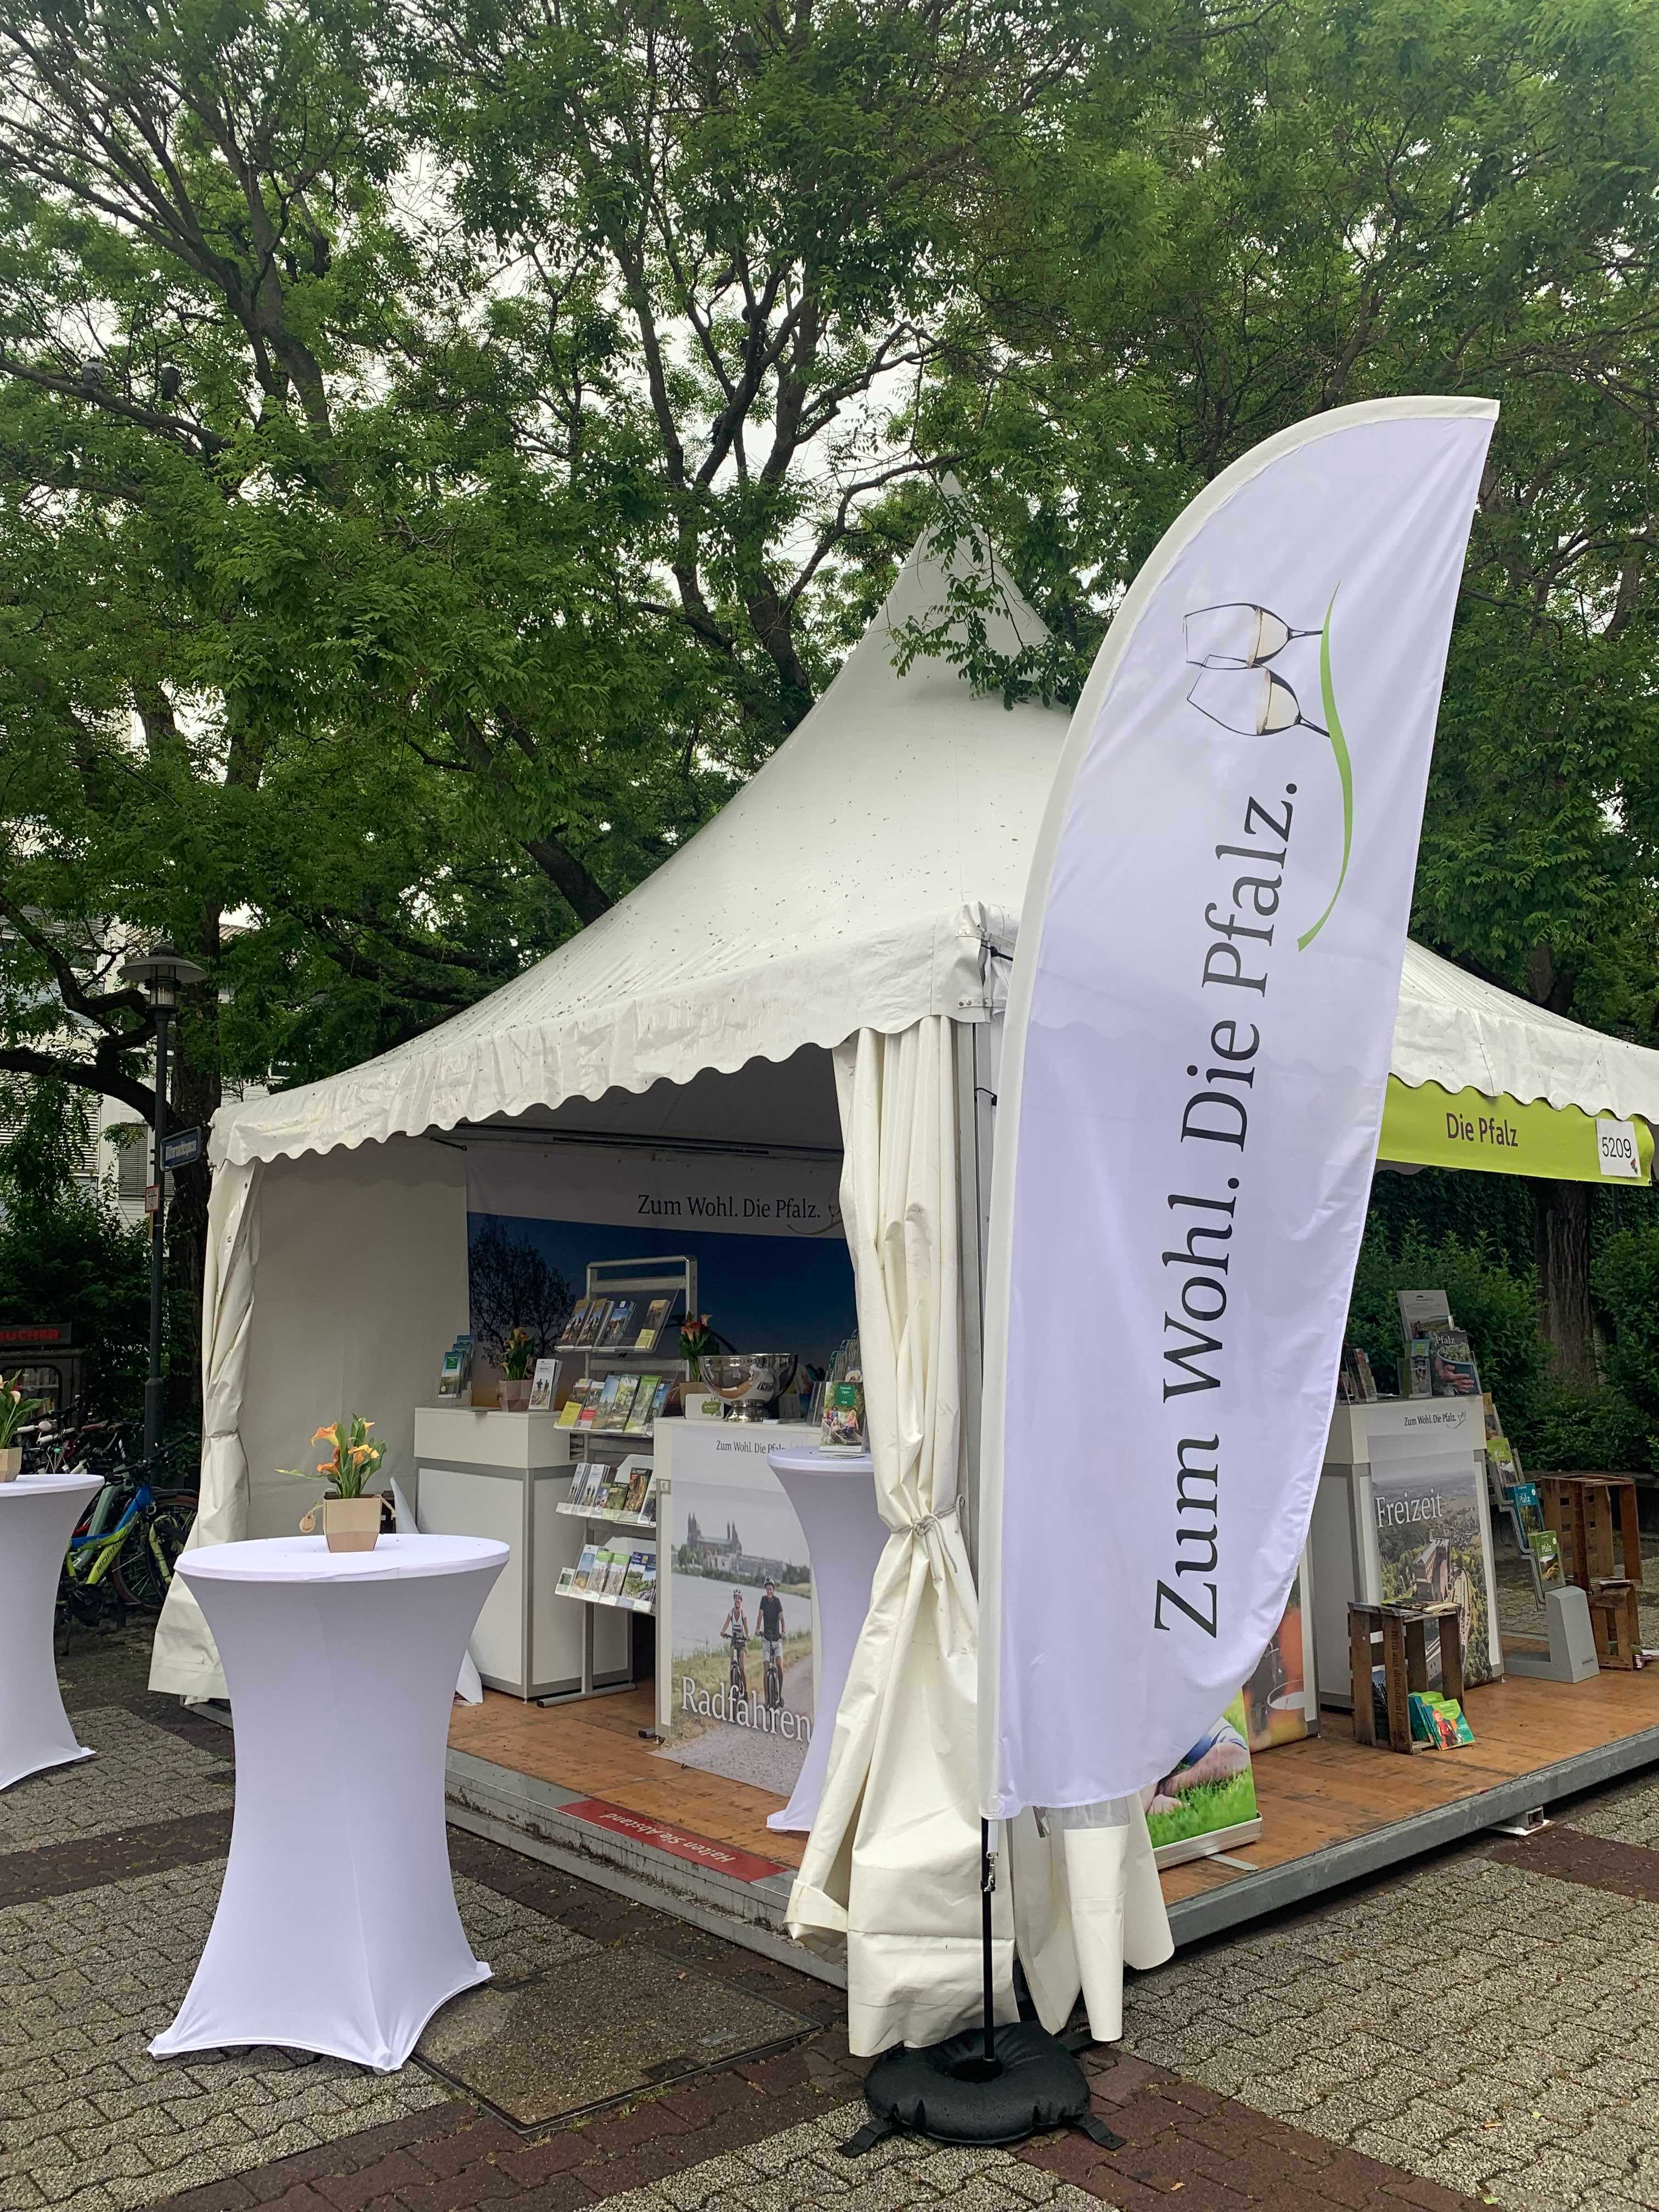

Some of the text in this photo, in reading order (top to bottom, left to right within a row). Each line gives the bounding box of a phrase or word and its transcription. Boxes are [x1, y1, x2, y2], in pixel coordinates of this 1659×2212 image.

[1446, 1113, 1519, 1147] Die Pfalz
[1602, 1137, 1632, 1158] 5209
[637, 1194, 821, 1218] Zum Wohl. Die Pfalz.
[1154, 783, 1298, 1639] Zum Wohl. Die Pfalz.
[1435, 1335, 1455, 1345] Pfalz
[1404, 1412, 1456, 1426] Zum Wohl. Die Pfalz.
[716, 1440, 732, 1451] Zum
[733, 1441, 753, 1453] Wohl.
[754, 1443, 766, 1454] Die
[1375, 1487, 1443, 1528] Freizeit
[680, 1675, 811, 1743] Radfahren
[600, 1812, 736, 1863] Halten Sie Abstand
